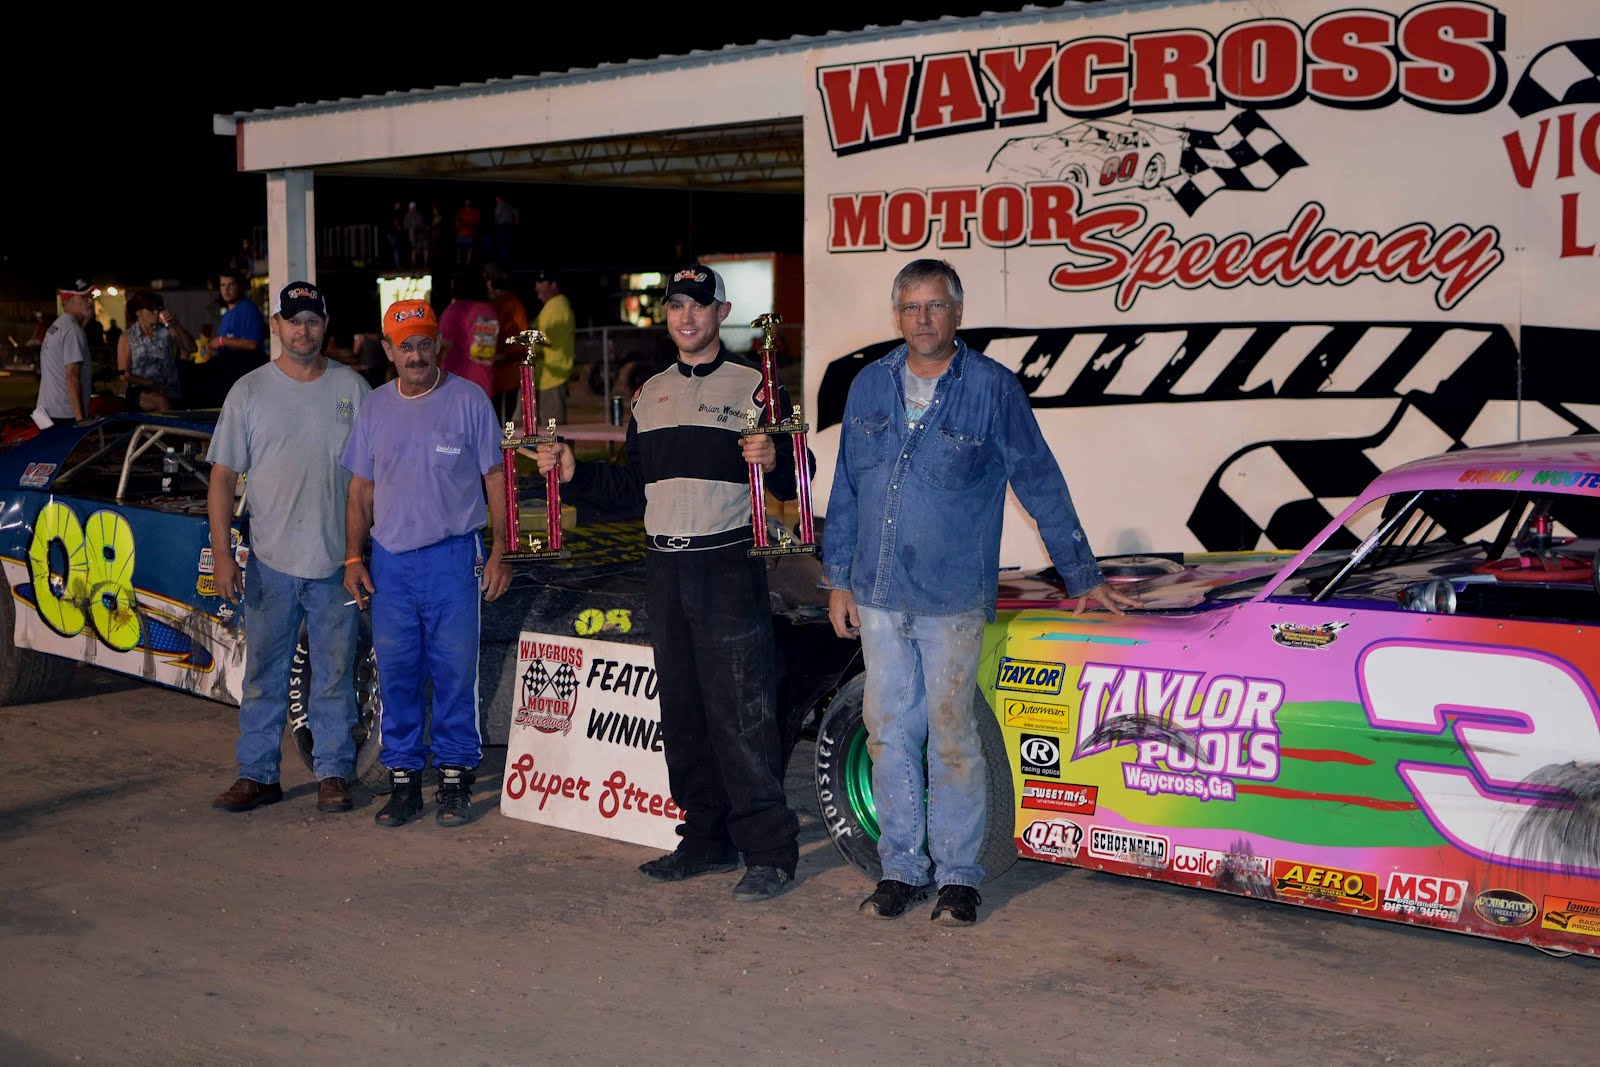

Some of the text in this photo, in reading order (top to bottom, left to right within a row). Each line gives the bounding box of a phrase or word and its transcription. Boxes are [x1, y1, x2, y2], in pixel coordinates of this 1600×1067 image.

[815, 1, 1505, 156] WAYCROSS
[828, 181, 1078, 253] MOTOR
[1050, 201, 1505, 311] Speedway
[698, 404, 720, 413] Brian
[1458, 469, 1524, 485] BRIAN
[29, 500, 141, 653] 08
[520, 640, 584, 670] WAYCROSS
[1001, 665, 1060, 687] TAYLOR
[527, 696, 570, 716] MOTOR
[1008, 702, 1066, 716] Outerwears
[1071, 662, 1285, 762] TAYLOR
[514, 706, 573, 737] Speedway
[1136, 731, 1280, 781] POOLS
[1355, 637, 1600, 880] 3
[506, 754, 590, 811] Super
[1021, 766, 1060, 776] racing optics
[1025, 787, 1064, 800] SWEET
[1028, 821, 1078, 849] QA1
[1093, 832, 1164, 857] SCHOENFELD
[1284, 866, 1363, 895] AERO
[1388, 874, 1462, 908] MSD
[1478, 896, 1534, 912] DOMINATOR
[1571, 924, 1600, 932] PRODU
